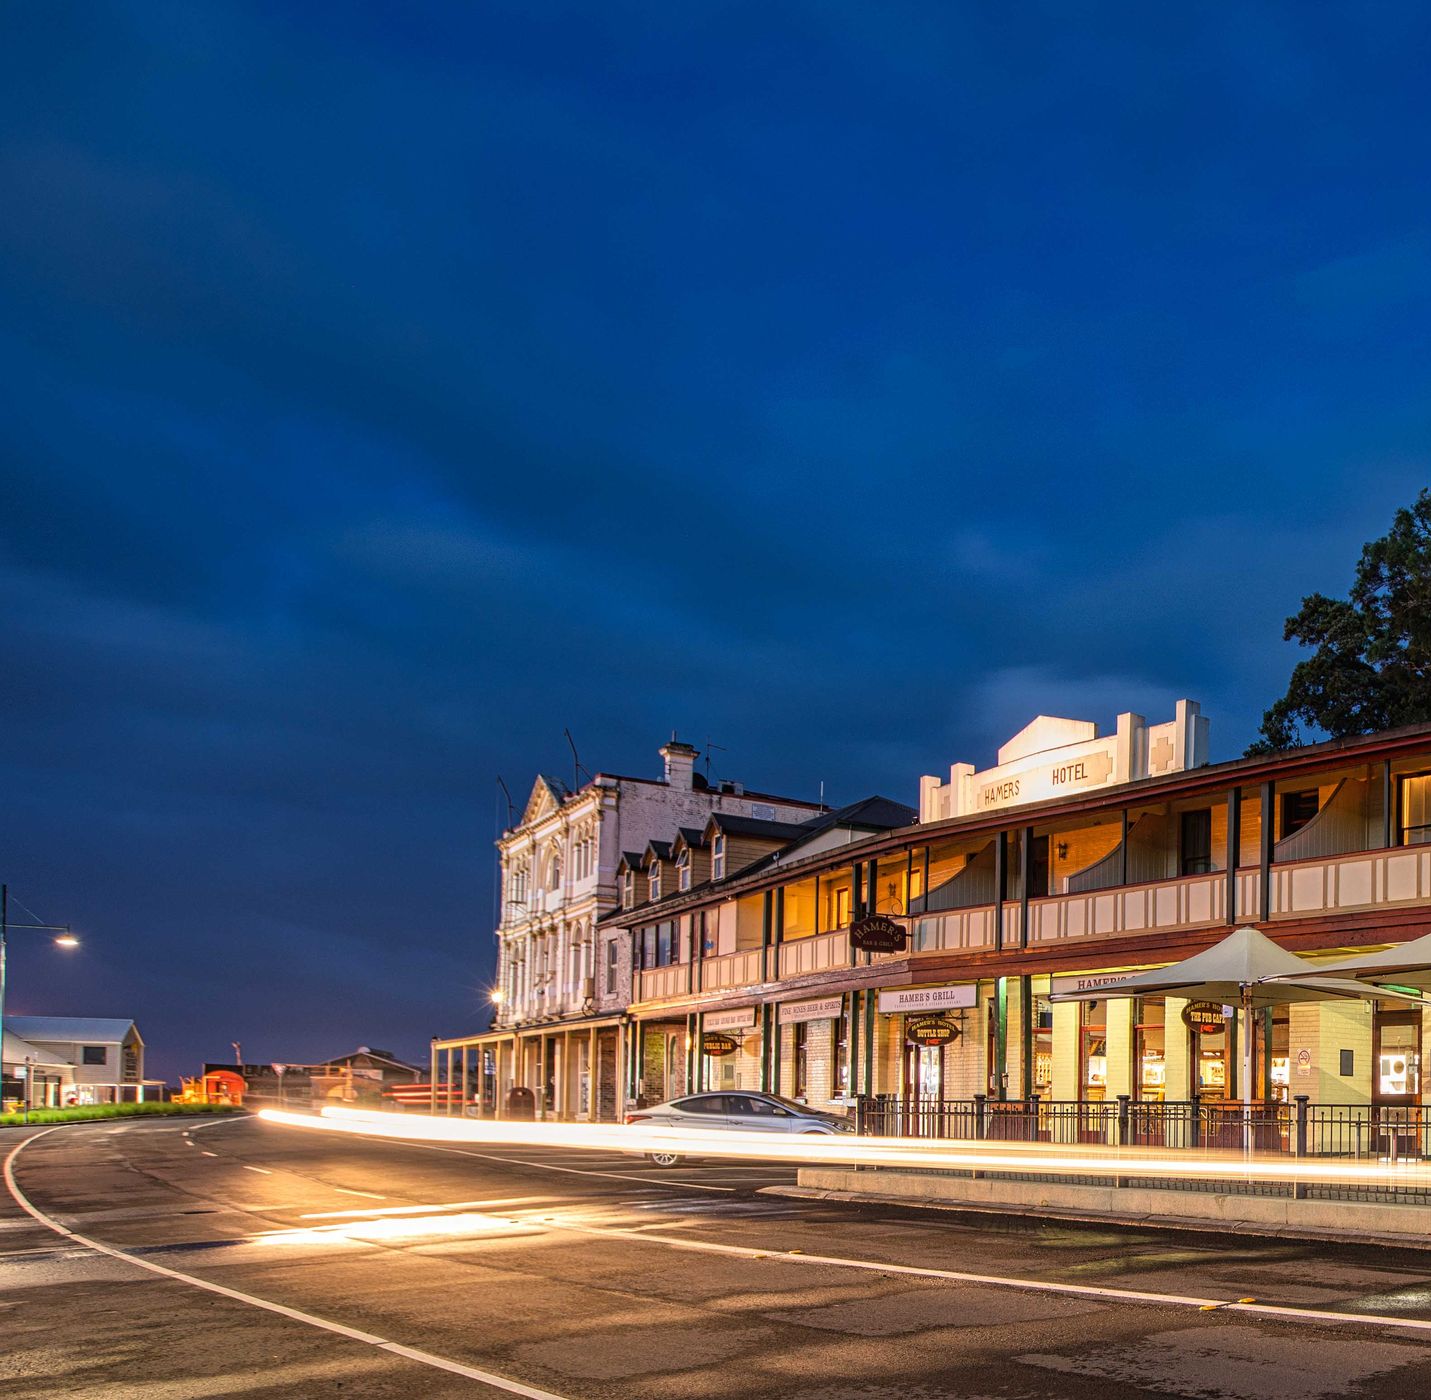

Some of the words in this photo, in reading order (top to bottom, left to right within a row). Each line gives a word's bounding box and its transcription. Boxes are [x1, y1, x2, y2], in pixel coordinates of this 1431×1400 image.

[984, 780, 1020, 806] HAMERS
[1052, 762, 1088, 786] HOTEL
[854, 921, 902, 942] HAMER'S
[899, 992, 930, 1003] HAMER'S
[932, 990, 955, 1001] GRILL
[824, 1001, 841, 1010] SPIRITS
[1186, 1002, 1210, 1014] HAMER'S
[1190, 1011, 1201, 1022] THE
[1202, 1012, 1212, 1023] PUB
[911, 1020, 935, 1032] HAMER'S
[937, 1020, 955, 1032] HOTEL
[917, 1028, 936, 1038] BOTTLE
[937, 1028, 950, 1038] SHOP
[721, 1042, 732, 1050] BAR
